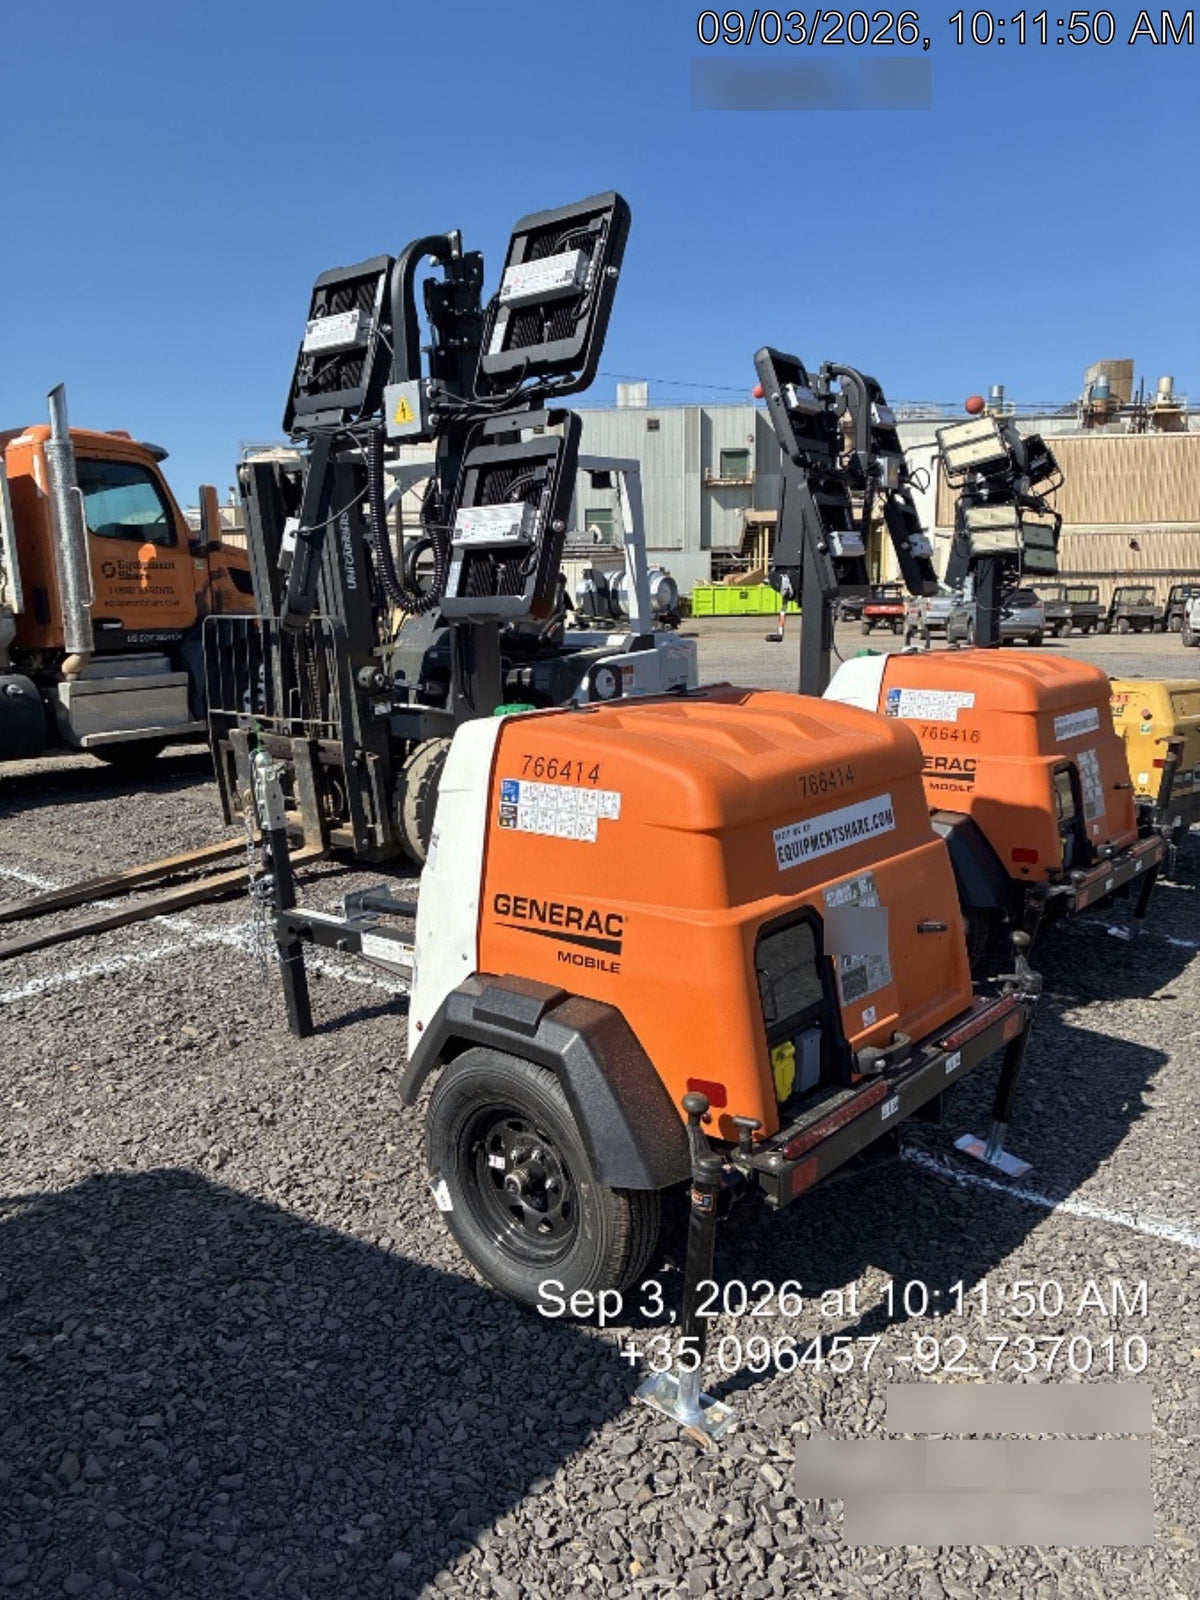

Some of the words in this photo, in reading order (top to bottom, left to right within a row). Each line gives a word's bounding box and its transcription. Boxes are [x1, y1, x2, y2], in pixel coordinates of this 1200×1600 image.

[920, 725, 981, 743] 766416
[521, 755, 600, 784] 766414
[924, 755, 977, 772] ERAC
[798, 764, 854, 797] 766414
[777, 808, 893, 863] EQUIPMENTSHARE.COM
[493, 893, 623, 937] GENERAC
[557, 950, 621, 974] MOBILE
